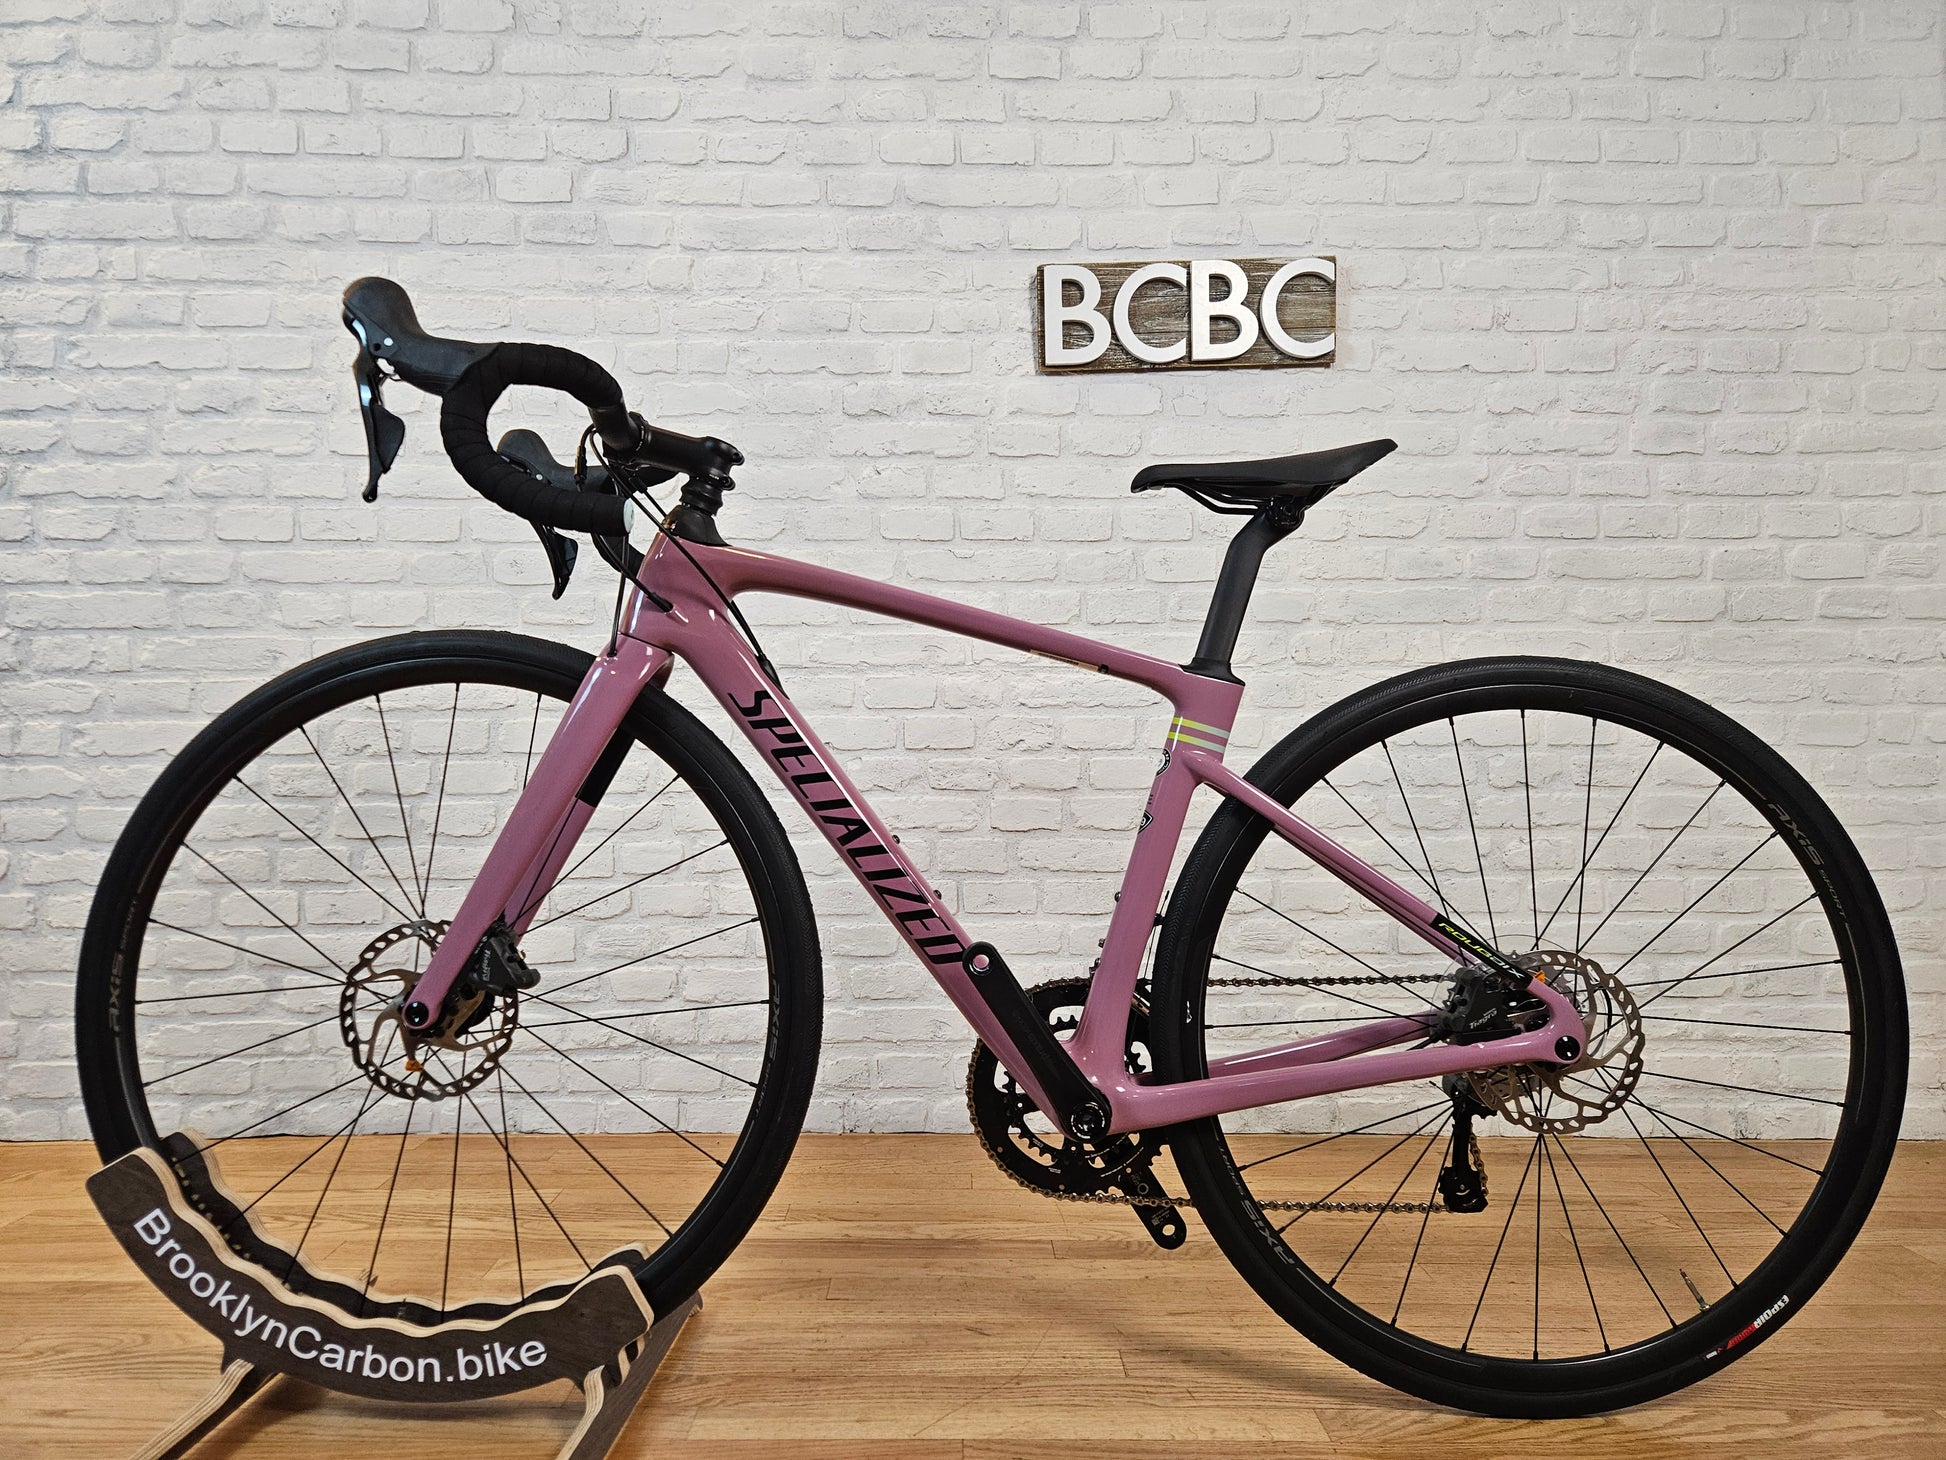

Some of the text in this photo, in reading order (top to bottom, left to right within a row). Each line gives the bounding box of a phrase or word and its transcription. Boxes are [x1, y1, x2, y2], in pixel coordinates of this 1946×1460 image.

[1043, 257, 1336, 366] BCBC
[727, 689, 967, 965] SPECIALIZED
[1767, 803, 1825, 866] AXIS
[1437, 922, 1526, 979] ROUBAIX
[1469, 1007, 1499, 1030] Tiagra
[1240, 1199, 1296, 1265] AXIS
[133, 1207, 548, 1383] BrooklynCarbon.bike
[1753, 1294, 1790, 1329] ESPOIR
